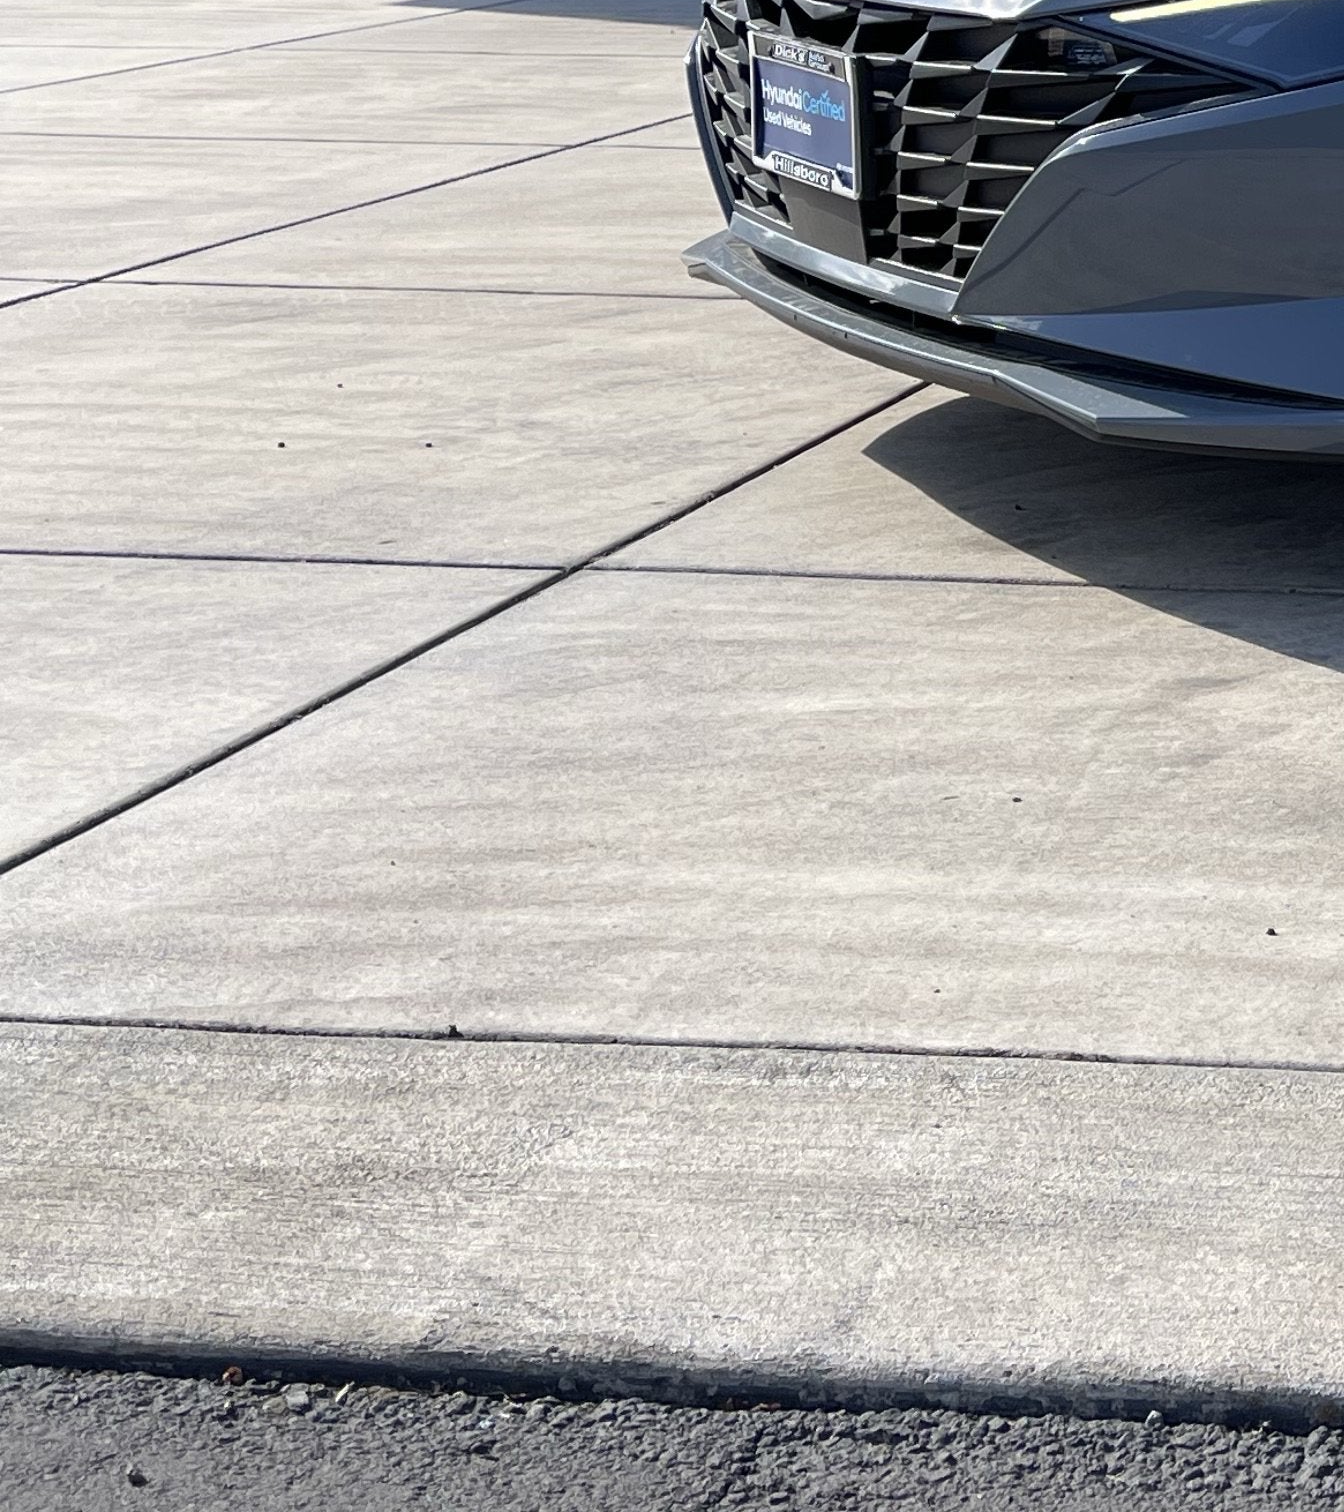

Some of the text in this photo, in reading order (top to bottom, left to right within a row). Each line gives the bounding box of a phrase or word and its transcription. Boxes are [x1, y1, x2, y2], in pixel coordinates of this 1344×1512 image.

[775, 44, 806, 63] Dick's
[761, 78, 846, 122] Hyundai Certified
[763, 107, 812, 137] Used Vehicles
[774, 155, 830, 187] Hillsboro
